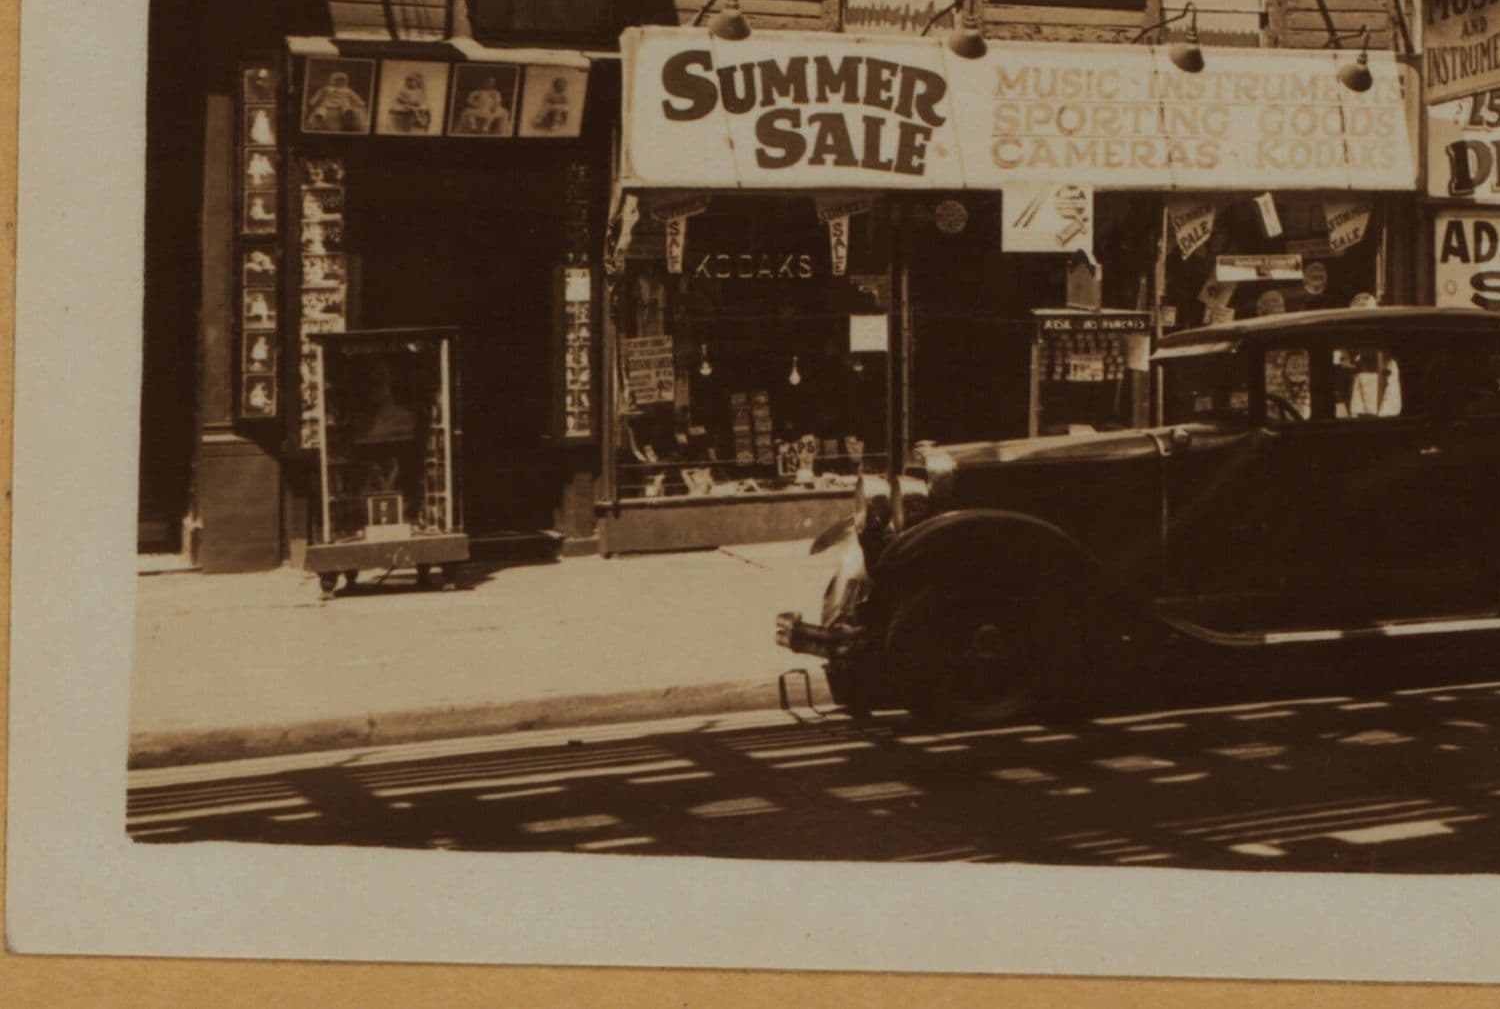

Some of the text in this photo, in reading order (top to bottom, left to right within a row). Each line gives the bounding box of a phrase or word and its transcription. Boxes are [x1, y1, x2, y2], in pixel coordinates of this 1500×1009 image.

[1460, 15, 1488, 39] AND
[661, 49, 948, 128] SUMMER
[993, 64, 1121, 100] MUSIC
[992, 102, 1396, 137] SPORTING GOODS
[755, 106, 934, 175] SALE
[989, 137, 1396, 171] CAMERAS KODAKS
[831, 222, 846, 276] SALE
[693, 254, 815, 280] KODAKS
